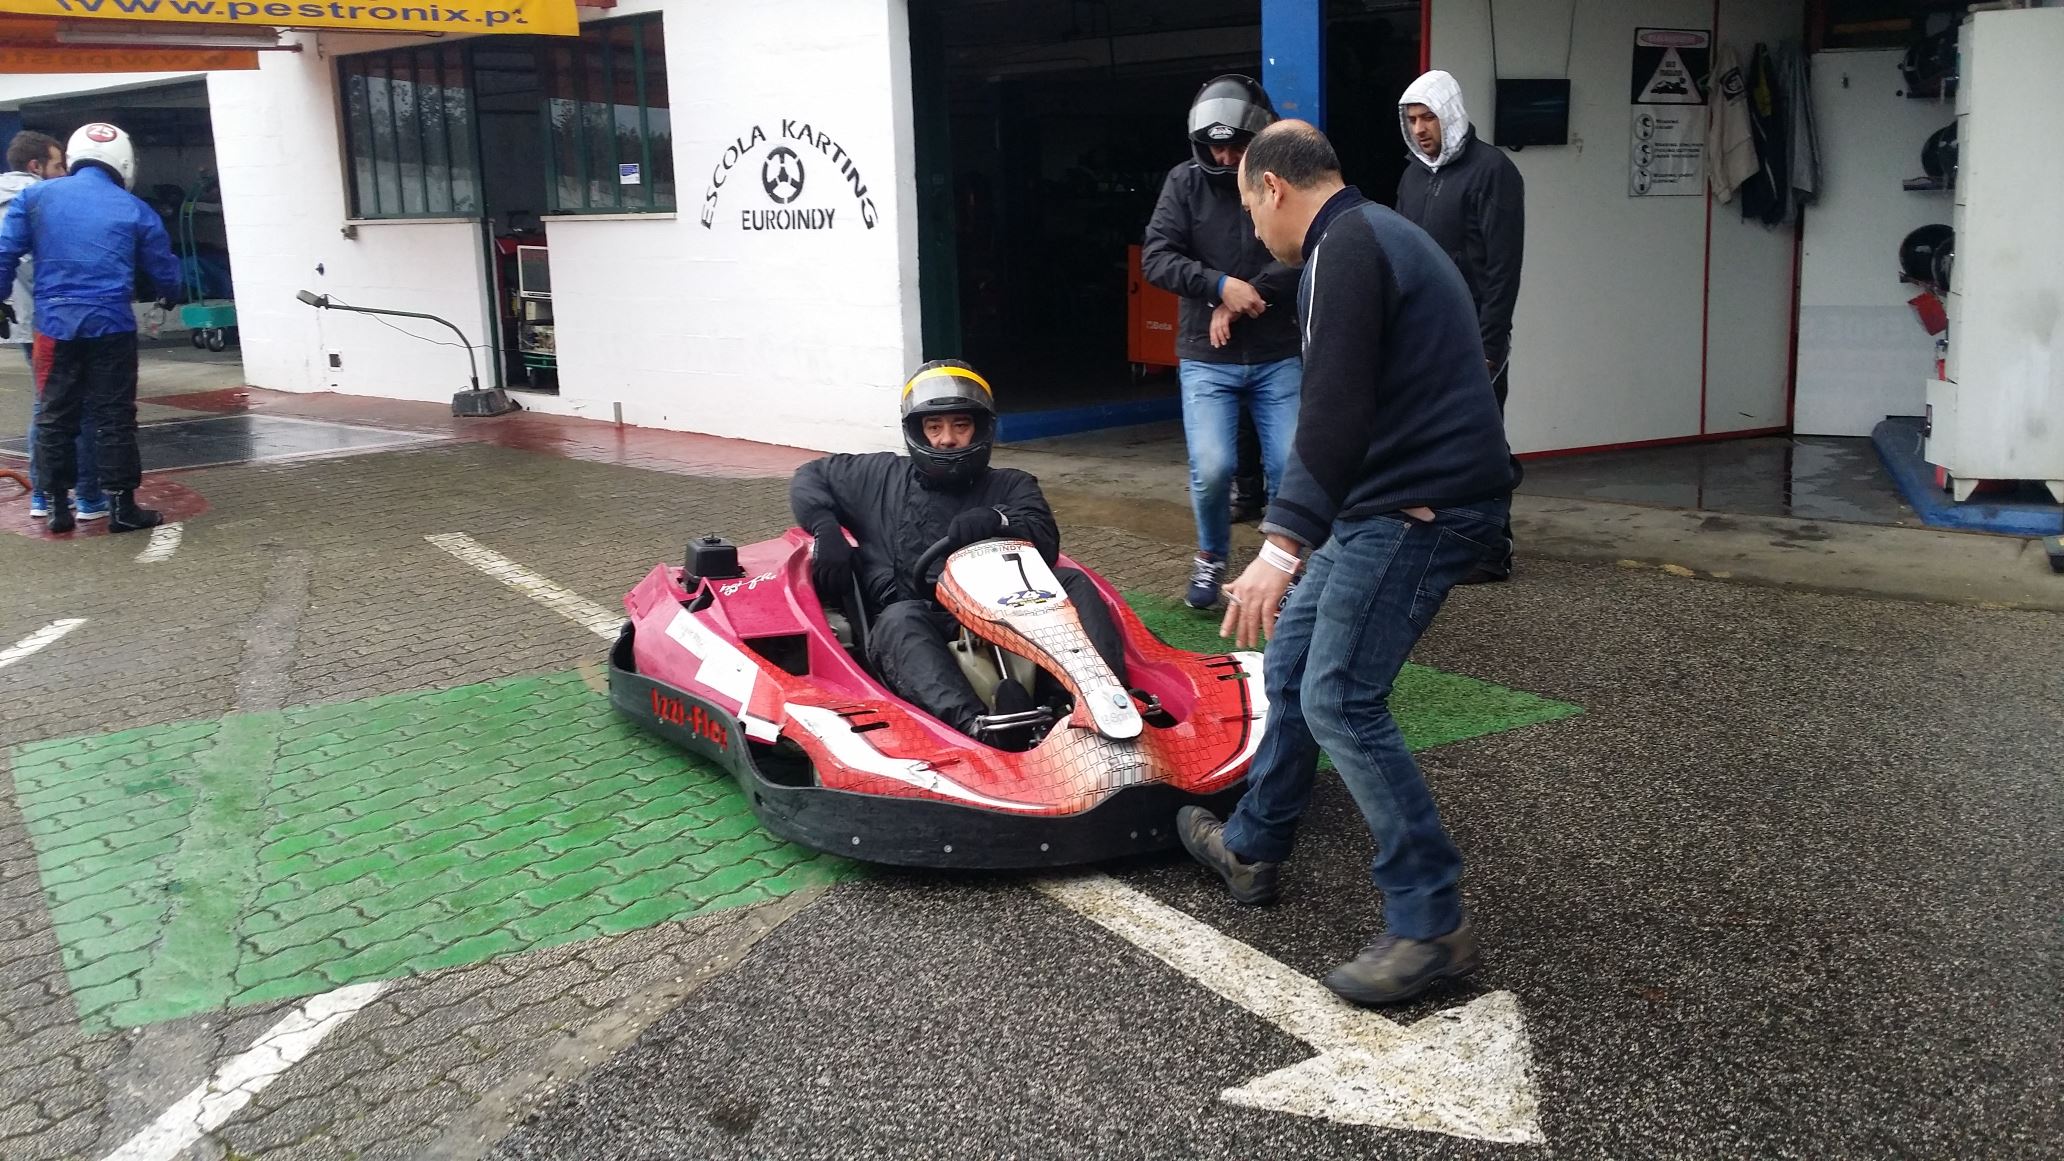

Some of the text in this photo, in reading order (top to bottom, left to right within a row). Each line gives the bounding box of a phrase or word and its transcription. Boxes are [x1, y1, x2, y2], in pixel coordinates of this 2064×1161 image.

[87, 125, 114, 138] 25
[700, 119, 879, 230] ESCOLA KARTING
[741, 208, 836, 231] EUROINDY
